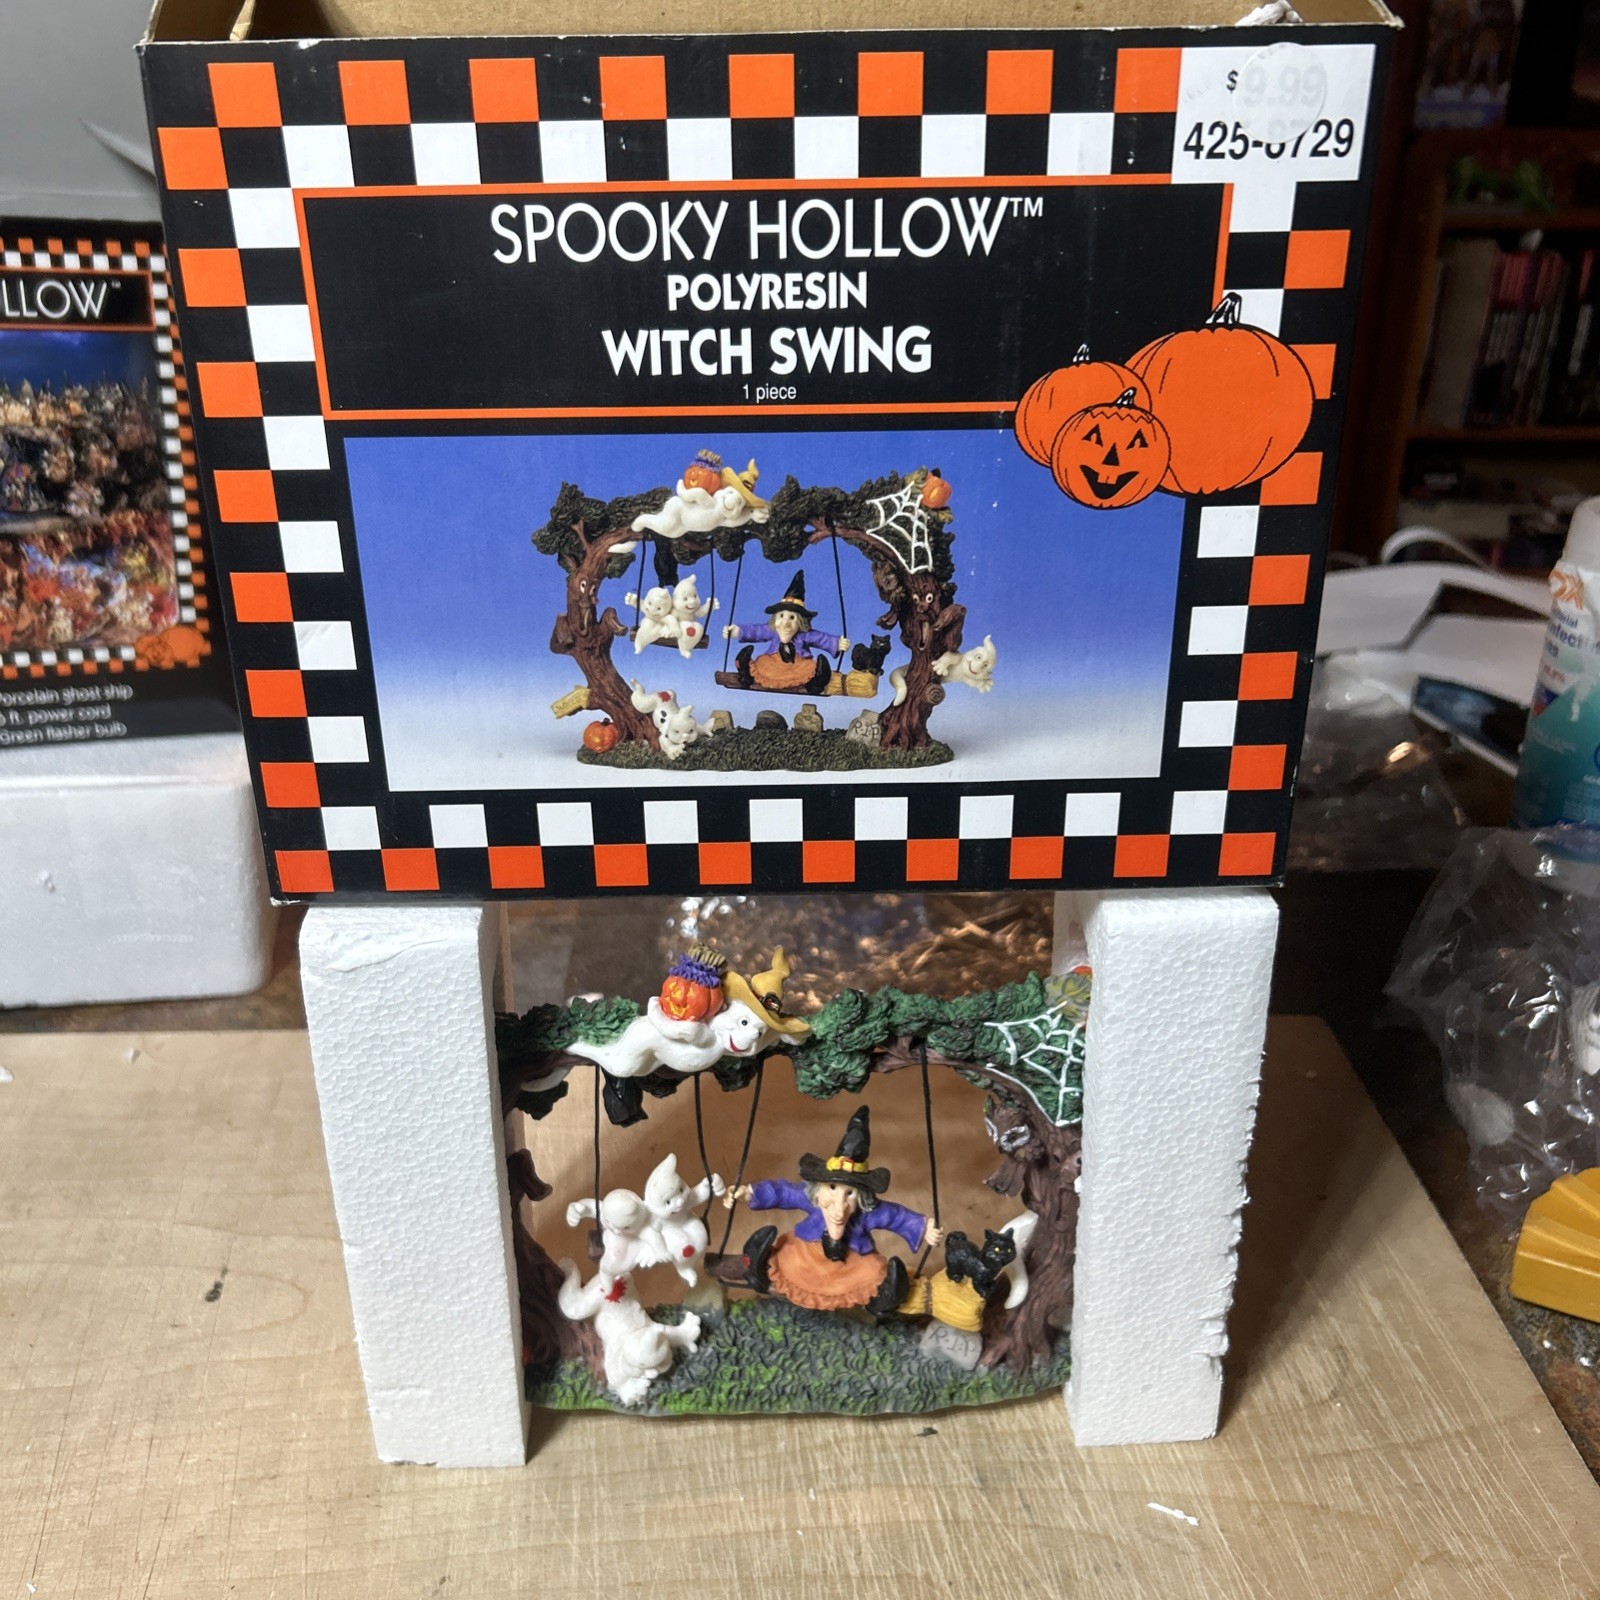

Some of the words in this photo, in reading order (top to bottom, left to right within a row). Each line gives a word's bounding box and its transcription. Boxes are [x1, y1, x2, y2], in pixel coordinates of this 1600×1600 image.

[491, 200, 730, 264] SPOOKY
[666, 271, 868, 312] POLYRESIN
[601, 328, 752, 376] WITCH
[769, 325, 933, 376] SWING
[742, 384, 750, 400] 1
[756, 383, 798, 404] piece
[61, 685, 102, 706] ghost
[28, 707, 75, 726] power
[75, 702, 112, 721] cord
